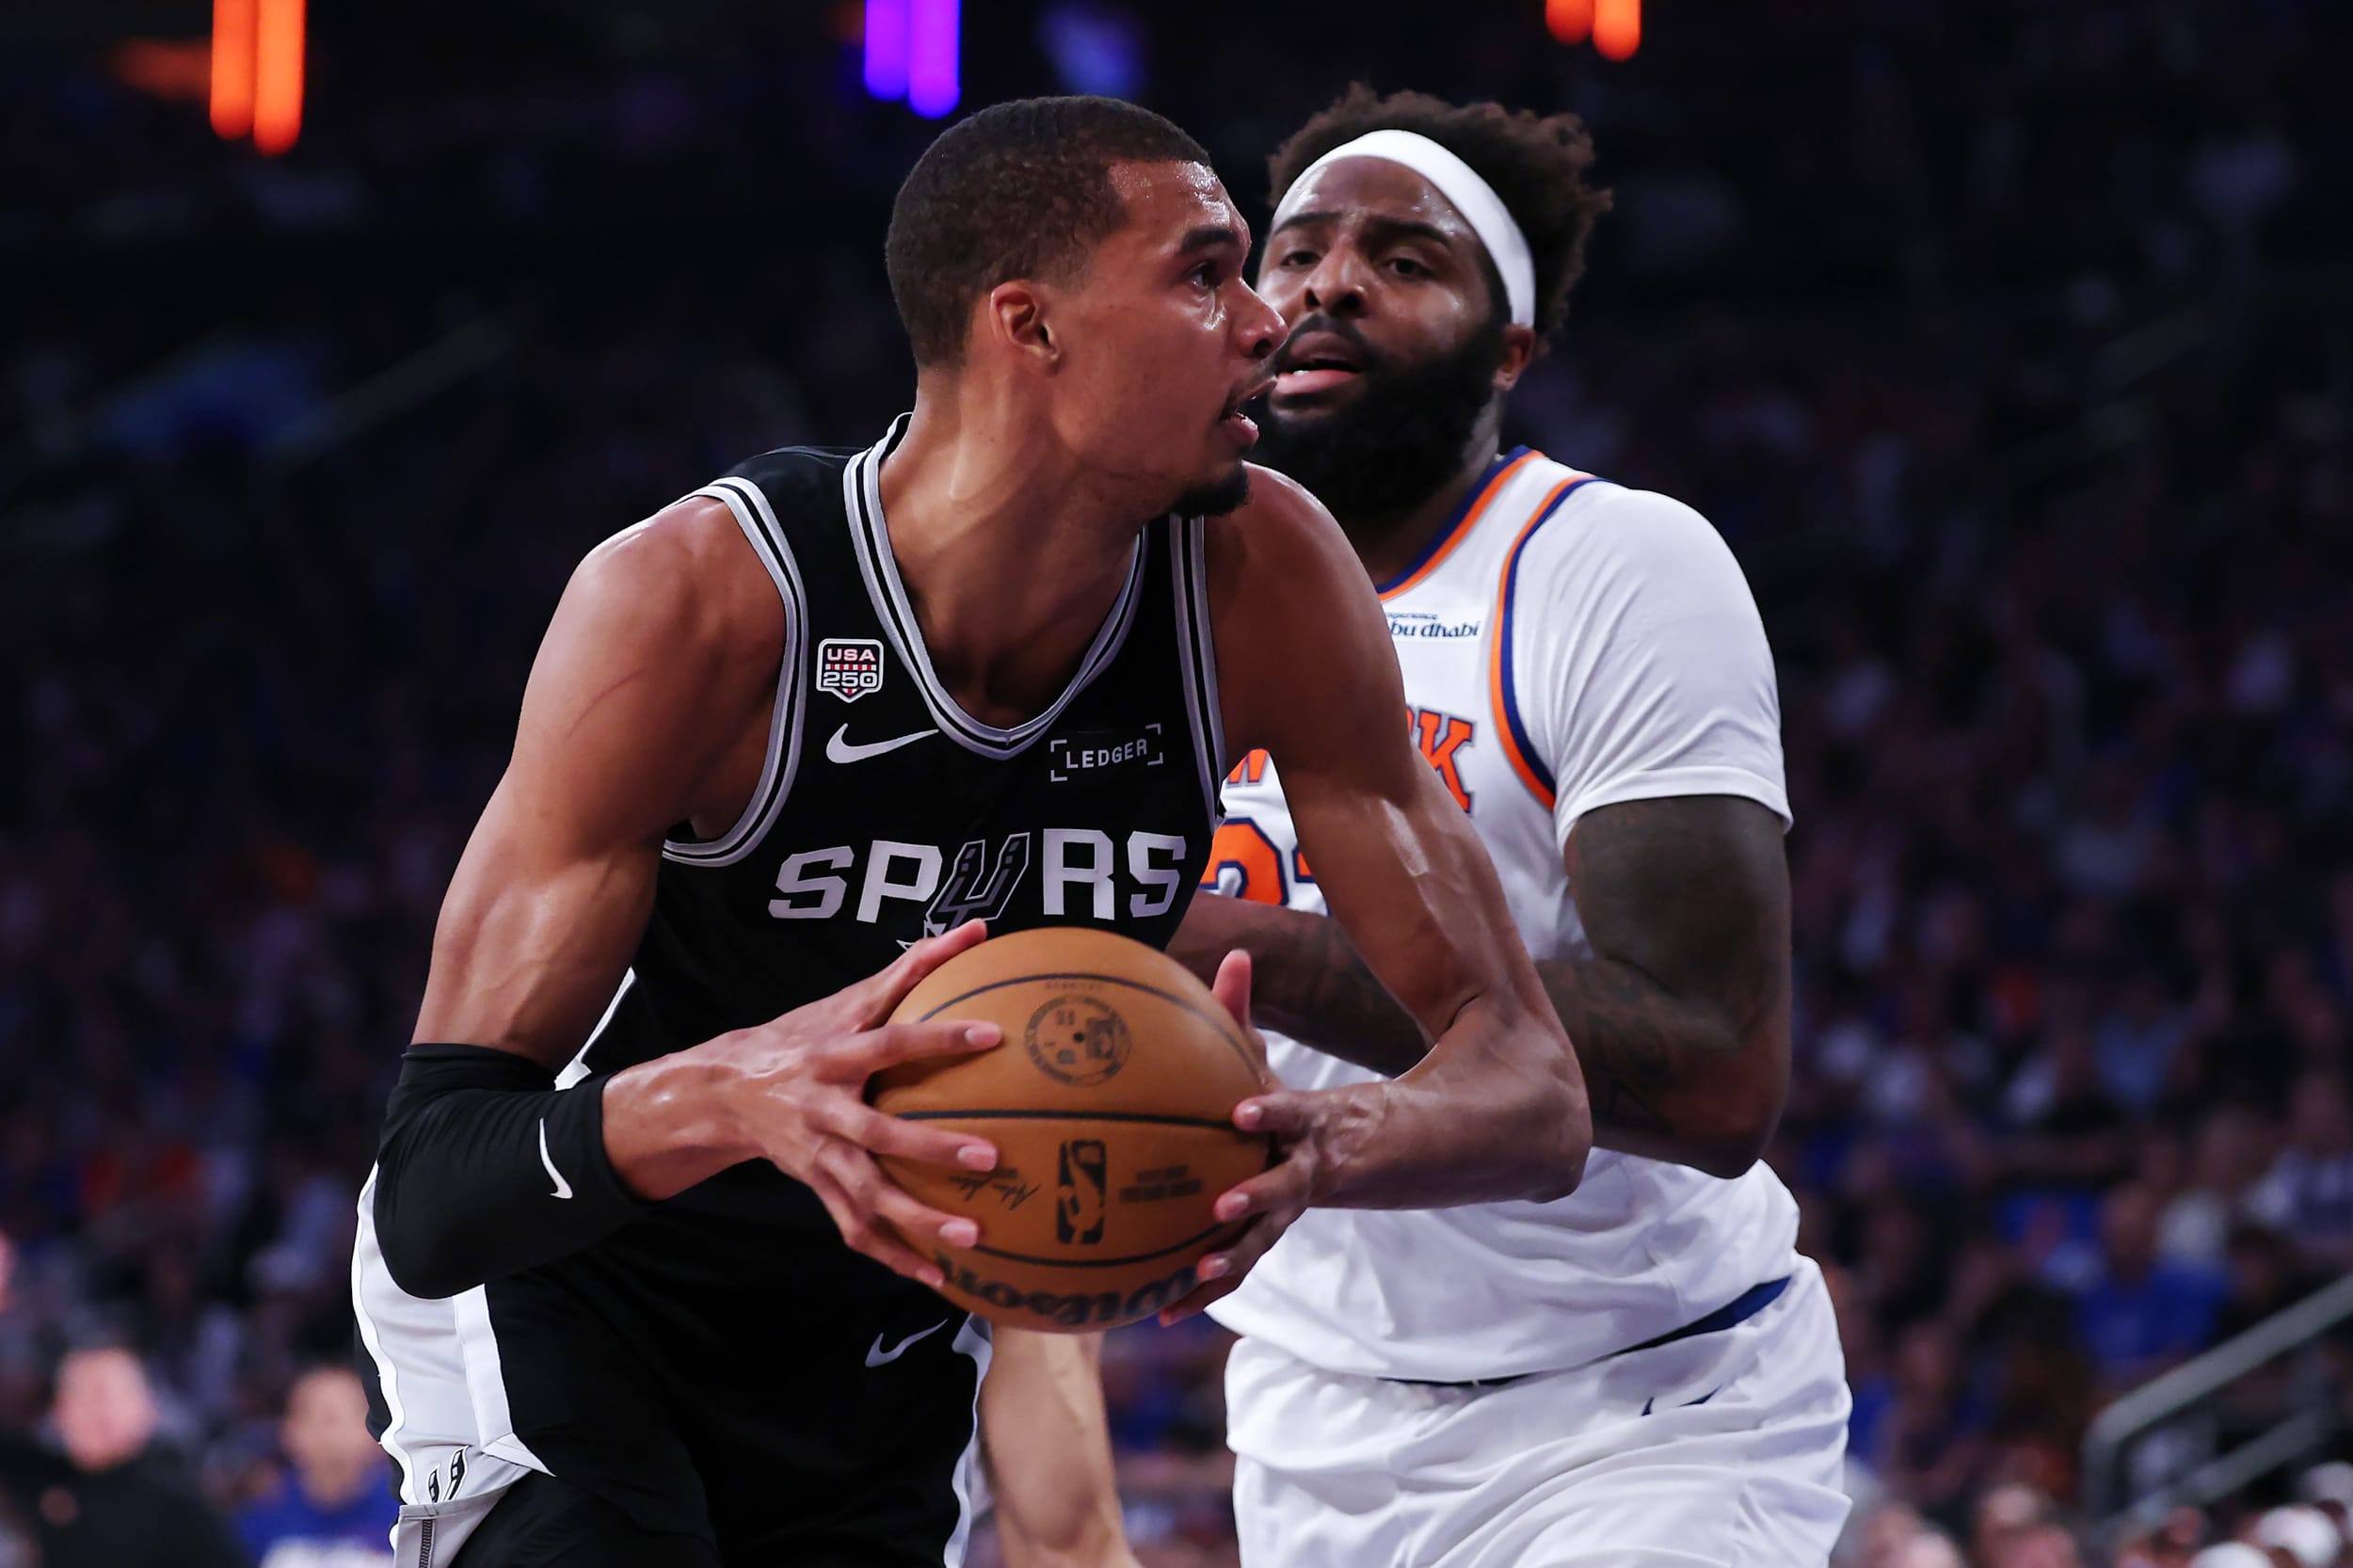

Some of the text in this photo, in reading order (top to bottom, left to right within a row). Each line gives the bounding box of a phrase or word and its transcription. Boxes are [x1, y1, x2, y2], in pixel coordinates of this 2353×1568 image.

[1390, 621, 1481, 637] bu dhabi
[826, 648, 876, 662] USA
[823, 671, 878, 688] 250
[1065, 738, 1148, 770] LEDGER
[768, 828, 1187, 923] SPURS
